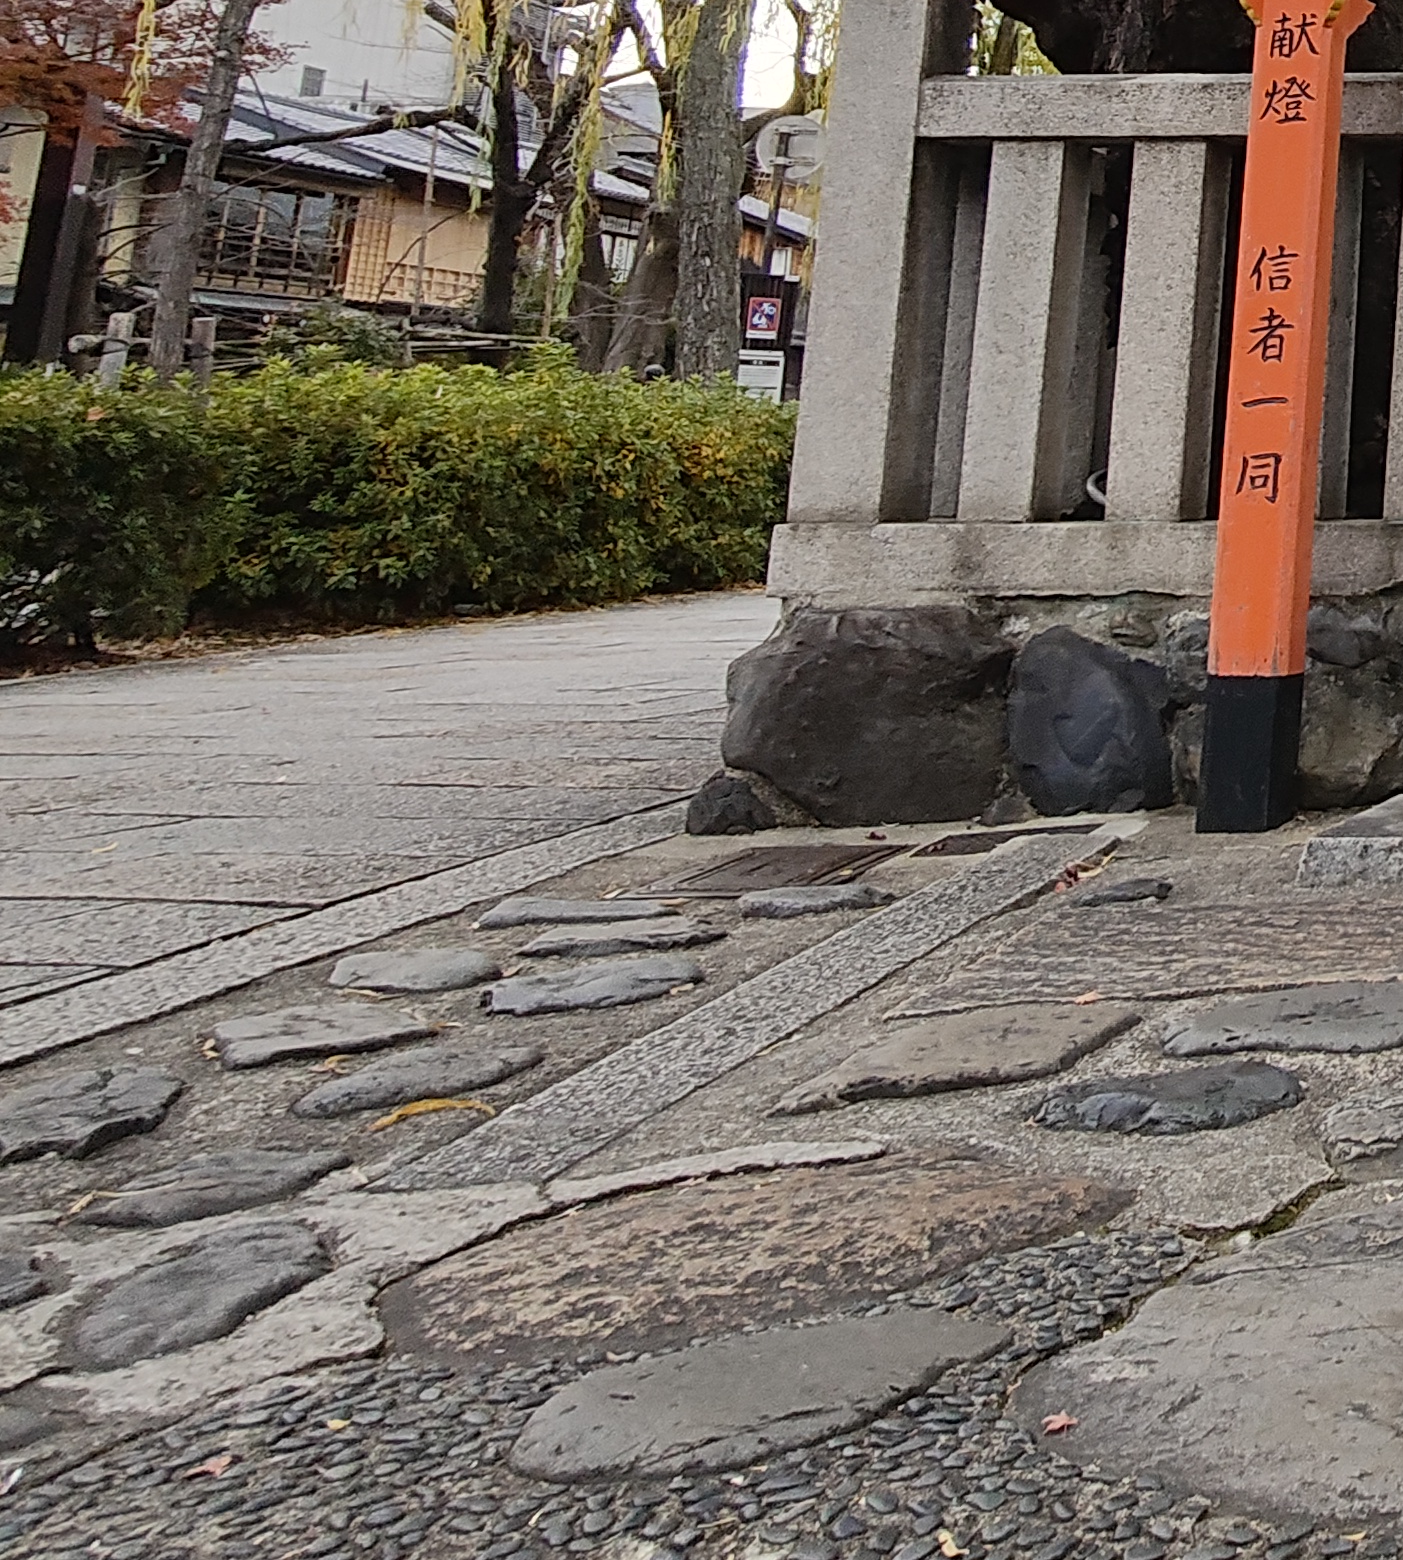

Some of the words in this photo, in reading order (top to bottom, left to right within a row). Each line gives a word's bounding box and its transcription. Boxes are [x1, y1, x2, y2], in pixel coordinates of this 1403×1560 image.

[1259, 12, 1320, 124] 献燈
[1235, 244, 1300, 505] 信者一同
